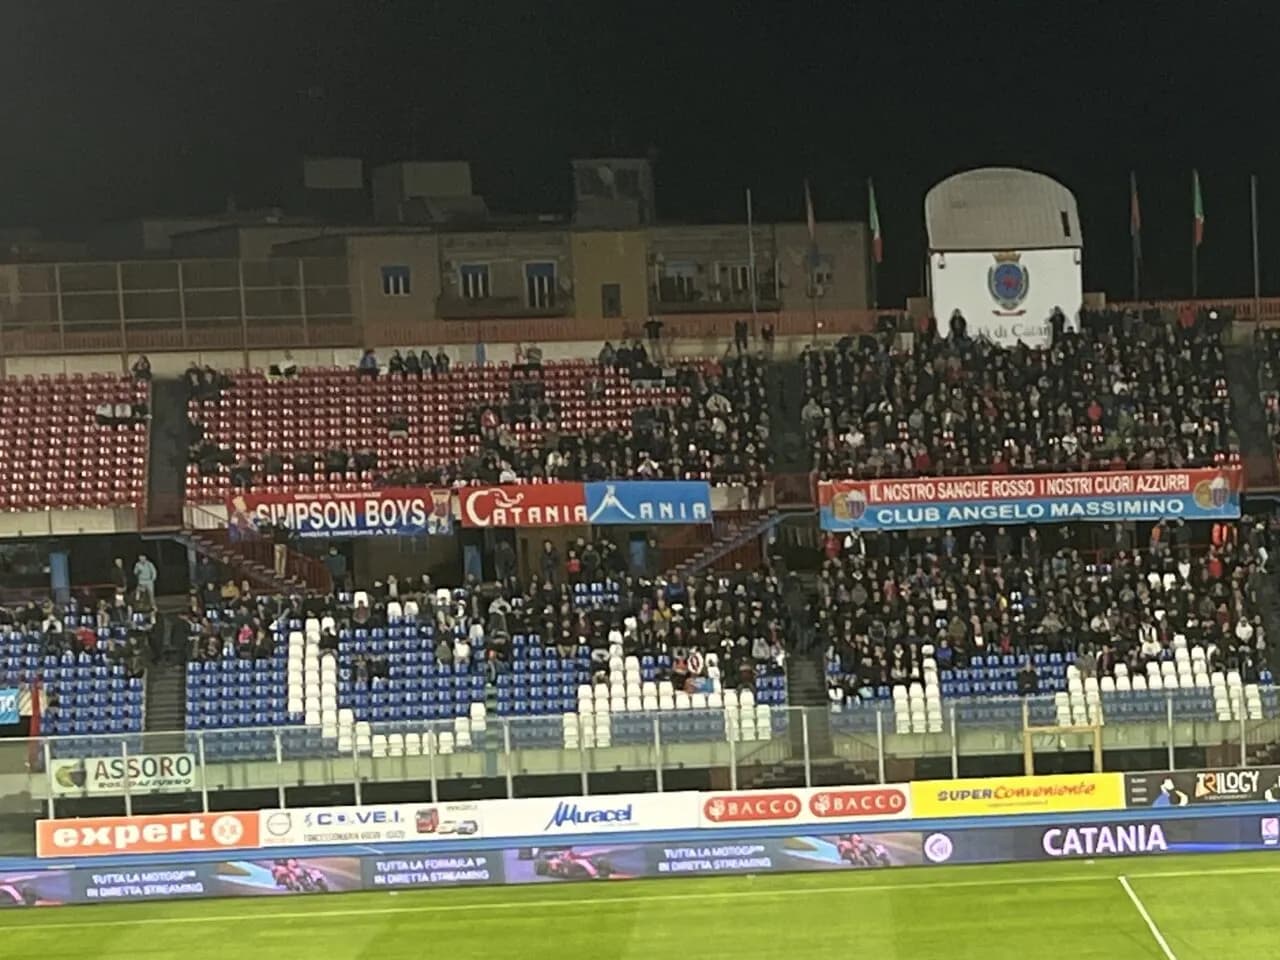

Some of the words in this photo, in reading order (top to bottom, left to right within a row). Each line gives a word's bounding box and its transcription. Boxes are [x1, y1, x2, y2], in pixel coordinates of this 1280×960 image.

[869, 485, 882, 501] IL
[883, 483, 934, 501] NOSTRO
[937, 481, 989, 499] SANGUE
[992, 479, 1034, 497] ROSSO
[1040, 480, 1044, 495] I
[1047, 478, 1092, 495] NOSTRI
[1095, 476, 1133, 493] CUORI
[1137, 474, 1190, 492] AZZURRI
[256, 501, 356, 529] SIMPSON
[365, 499, 425, 526] BOYS
[466, 488, 587, 526] CATANIA
[877, 508, 940, 524] CLUB
[947, 503, 1044, 521] ANGELO
[1051, 499, 1184, 517] MASSIMINO
[94, 756, 192, 780] ASSORO
[728, 799, 797, 816] BACCO
[834, 794, 903, 811] BACCO
[53, 818, 205, 849] expert
[1043, 824, 1168, 856] CATANIA
[697, 847, 710, 857] LA
[410, 860, 423, 870] LA
[127, 873, 140, 883] LA
